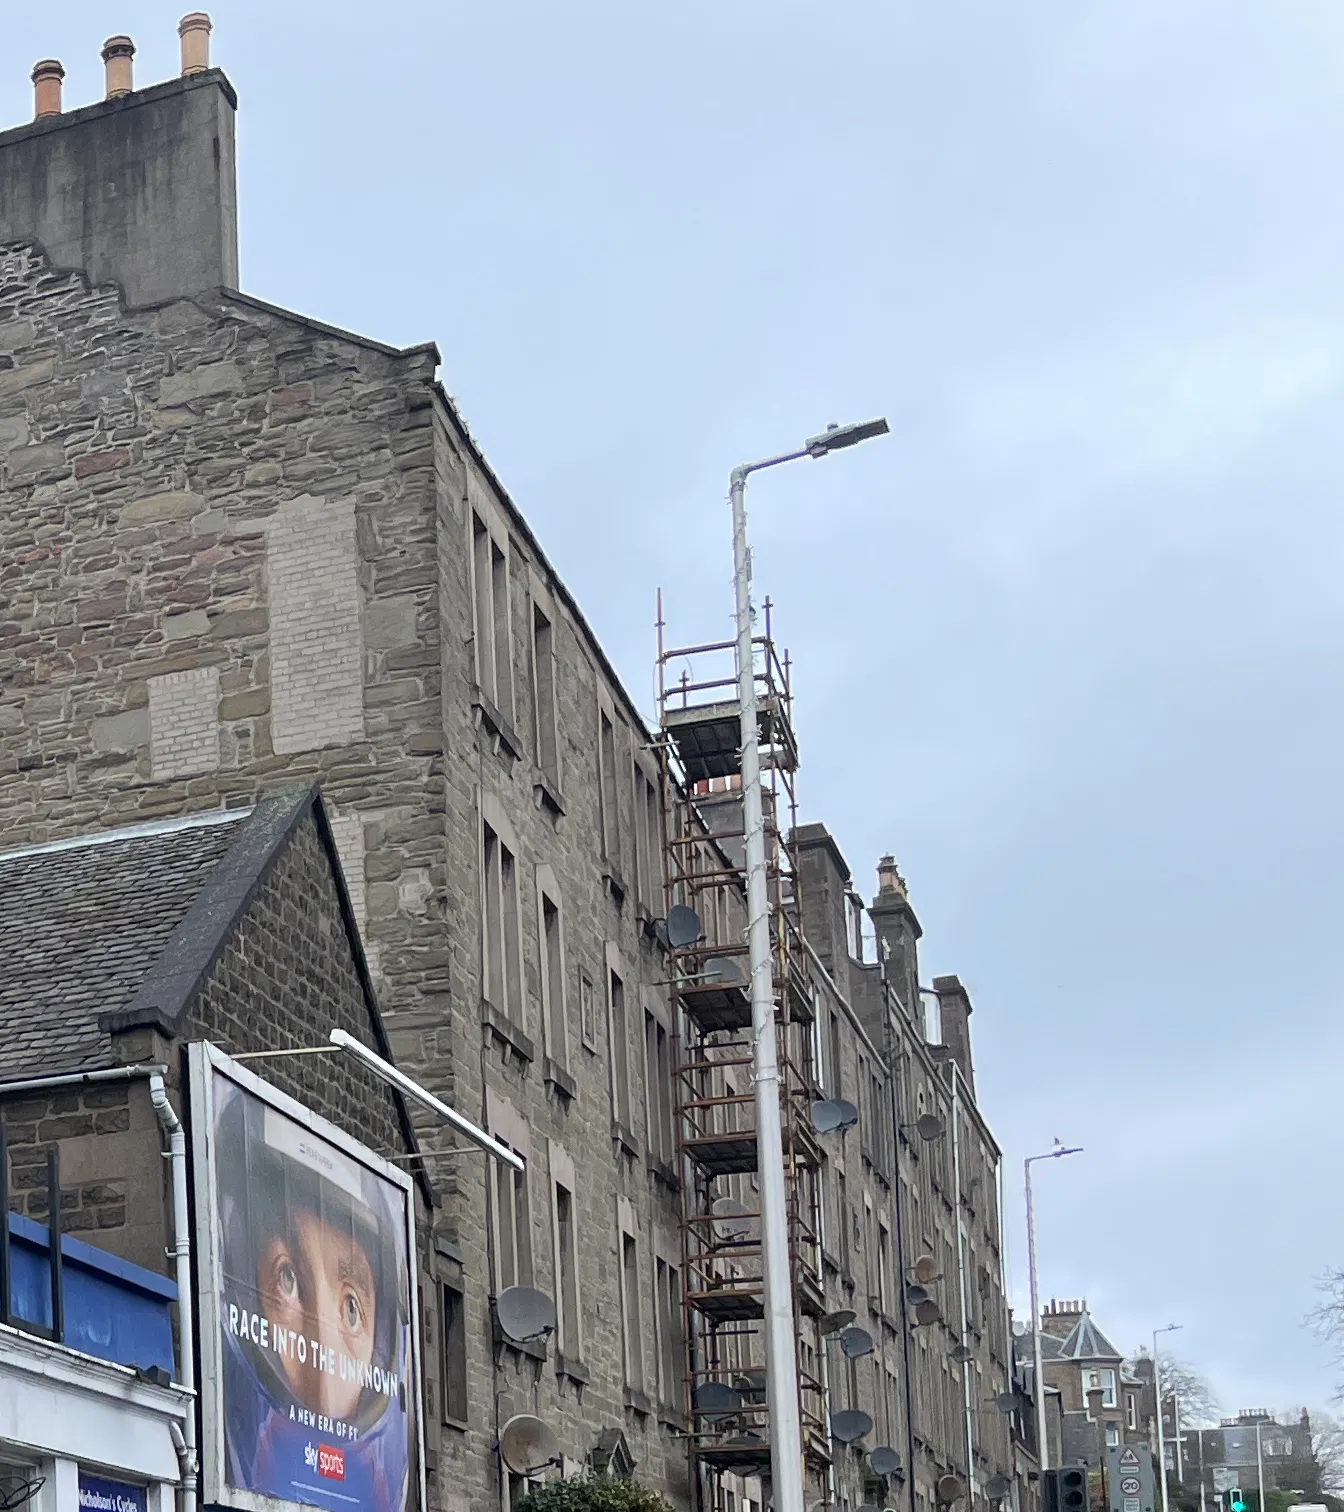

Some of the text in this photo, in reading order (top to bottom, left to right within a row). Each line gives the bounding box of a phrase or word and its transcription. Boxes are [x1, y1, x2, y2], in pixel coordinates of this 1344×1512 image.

[229, 1303, 399, 1397] RACE INTO THE UNKNOWN
[289, 1404, 296, 1421] A
[297, 1407, 316, 1428] NEW
[318, 1414, 334, 1435] ERA
[336, 1421, 348, 1438] OF
[304, 1441, 344, 1476] sky sports
[1123, 1481, 1138, 1490] 20
